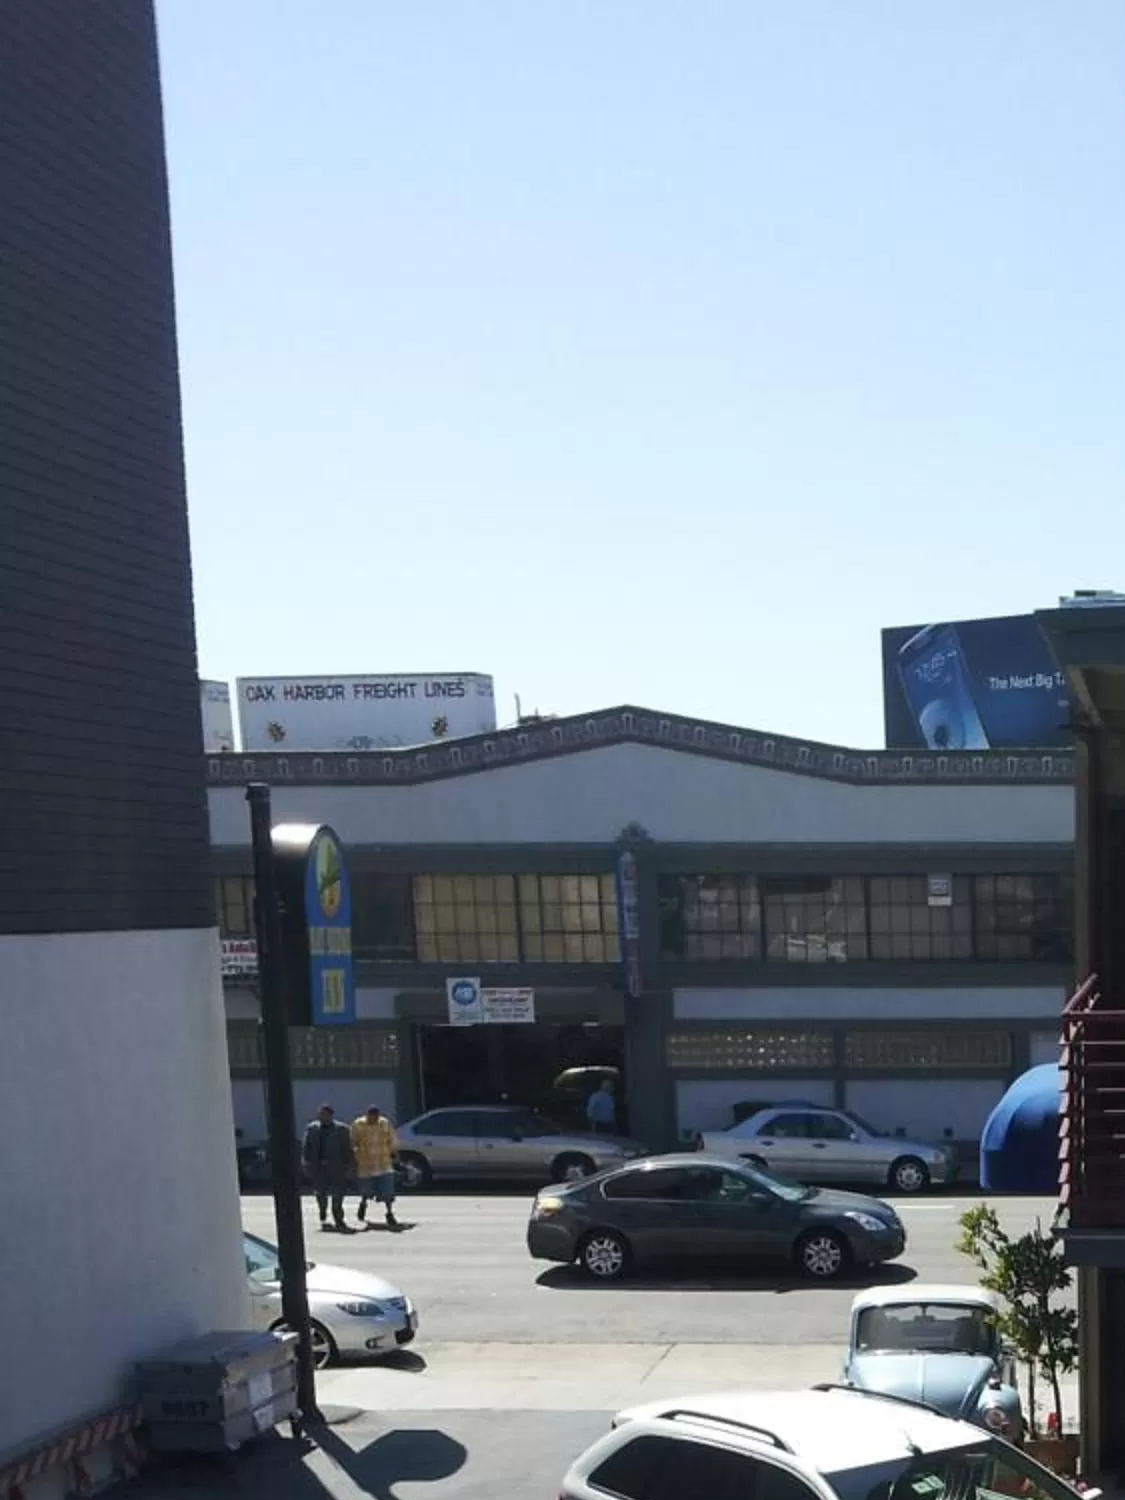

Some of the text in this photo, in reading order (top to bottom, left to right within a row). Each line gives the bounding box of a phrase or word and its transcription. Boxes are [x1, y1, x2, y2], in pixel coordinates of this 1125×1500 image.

[246, 684, 276, 702] OAK
[283, 683, 344, 702] HARBOR
[353, 682, 417, 700] FREIGHT
[423, 680, 465, 698] LINES
[990, 676, 1009, 689] The
[1009, 675, 1033, 689] Next
[1035, 673, 1054, 690] Big
